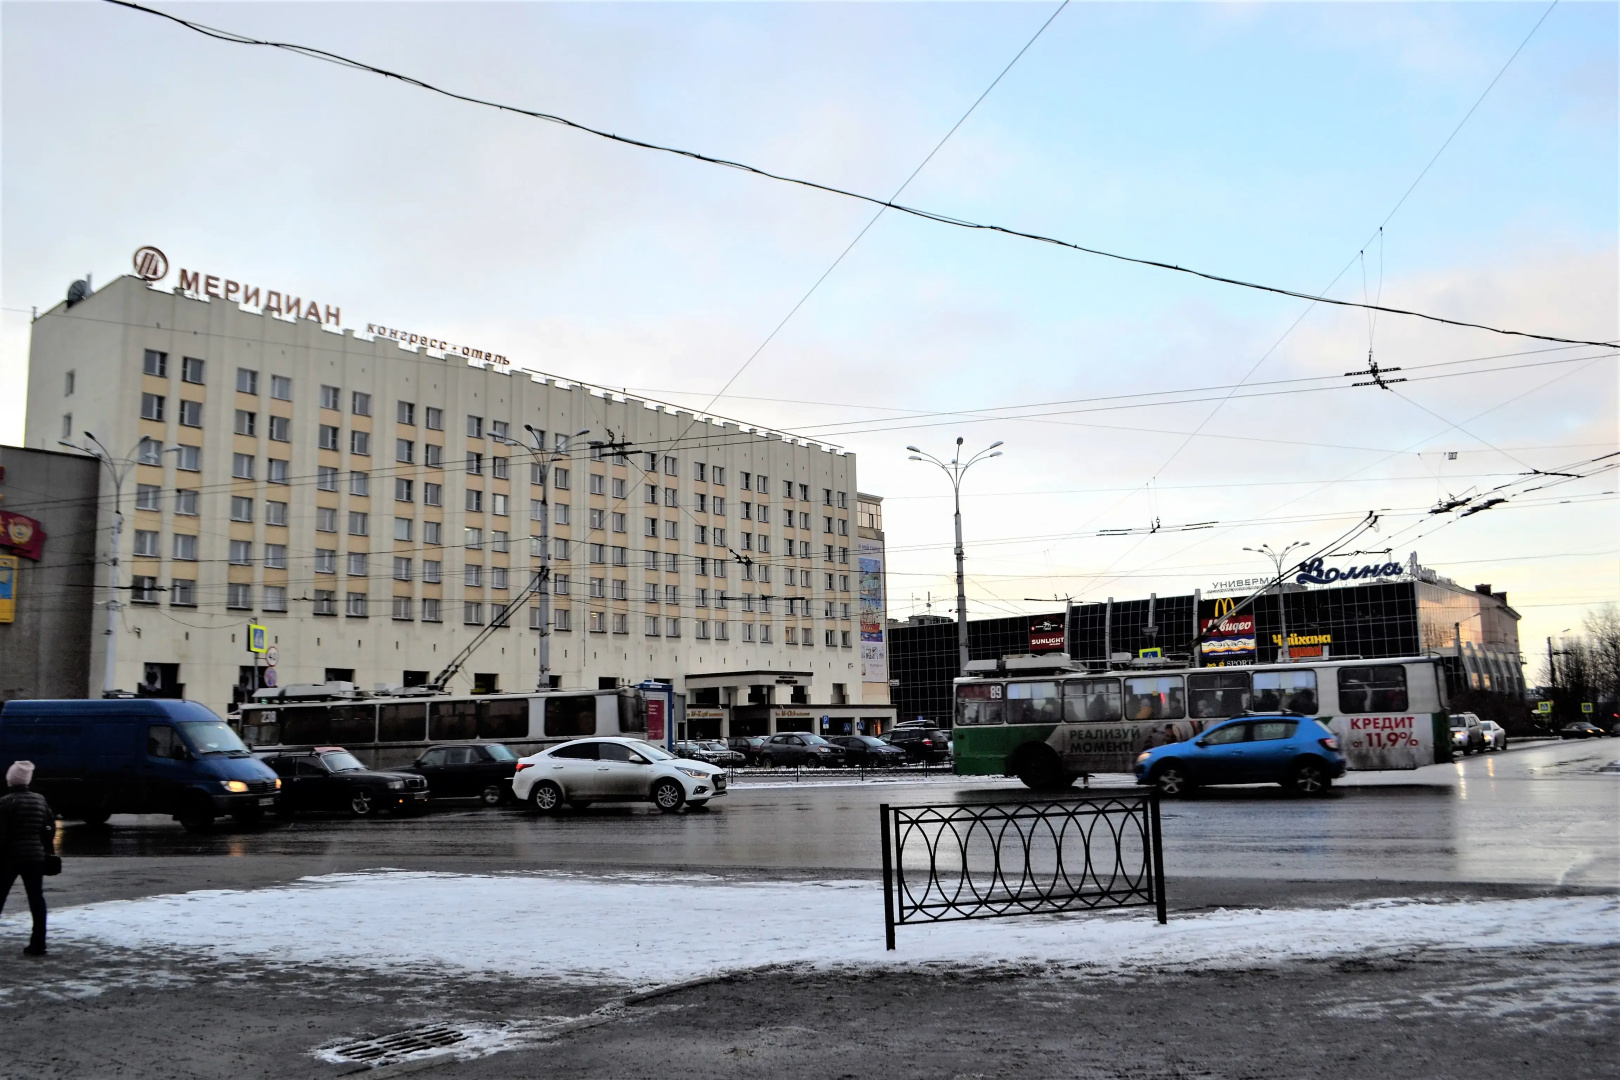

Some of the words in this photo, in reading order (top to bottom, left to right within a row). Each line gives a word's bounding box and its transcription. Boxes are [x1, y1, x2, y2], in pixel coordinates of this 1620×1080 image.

[179, 268, 341, 327] МЕРИДИАН
[367, 323, 447, 351] конгресс
[462, 346, 511, 366] отель
[1296, 557, 1404, 585] Волна
[1212, 576, 1284, 589] УНИВЕРМА
[1031, 637, 1065, 645] SUNLIGHT
[990, 686, 1002, 699] 89
[1350, 717, 1415, 731] КРЕДИТ
[1069, 725, 1141, 740] РЕАЛИЗУЙ
[1070, 741, 1134, 753] МОМЕНТ!
[1352, 740, 1363, 748] от
[1366, 731, 1419, 750] 11,9%
